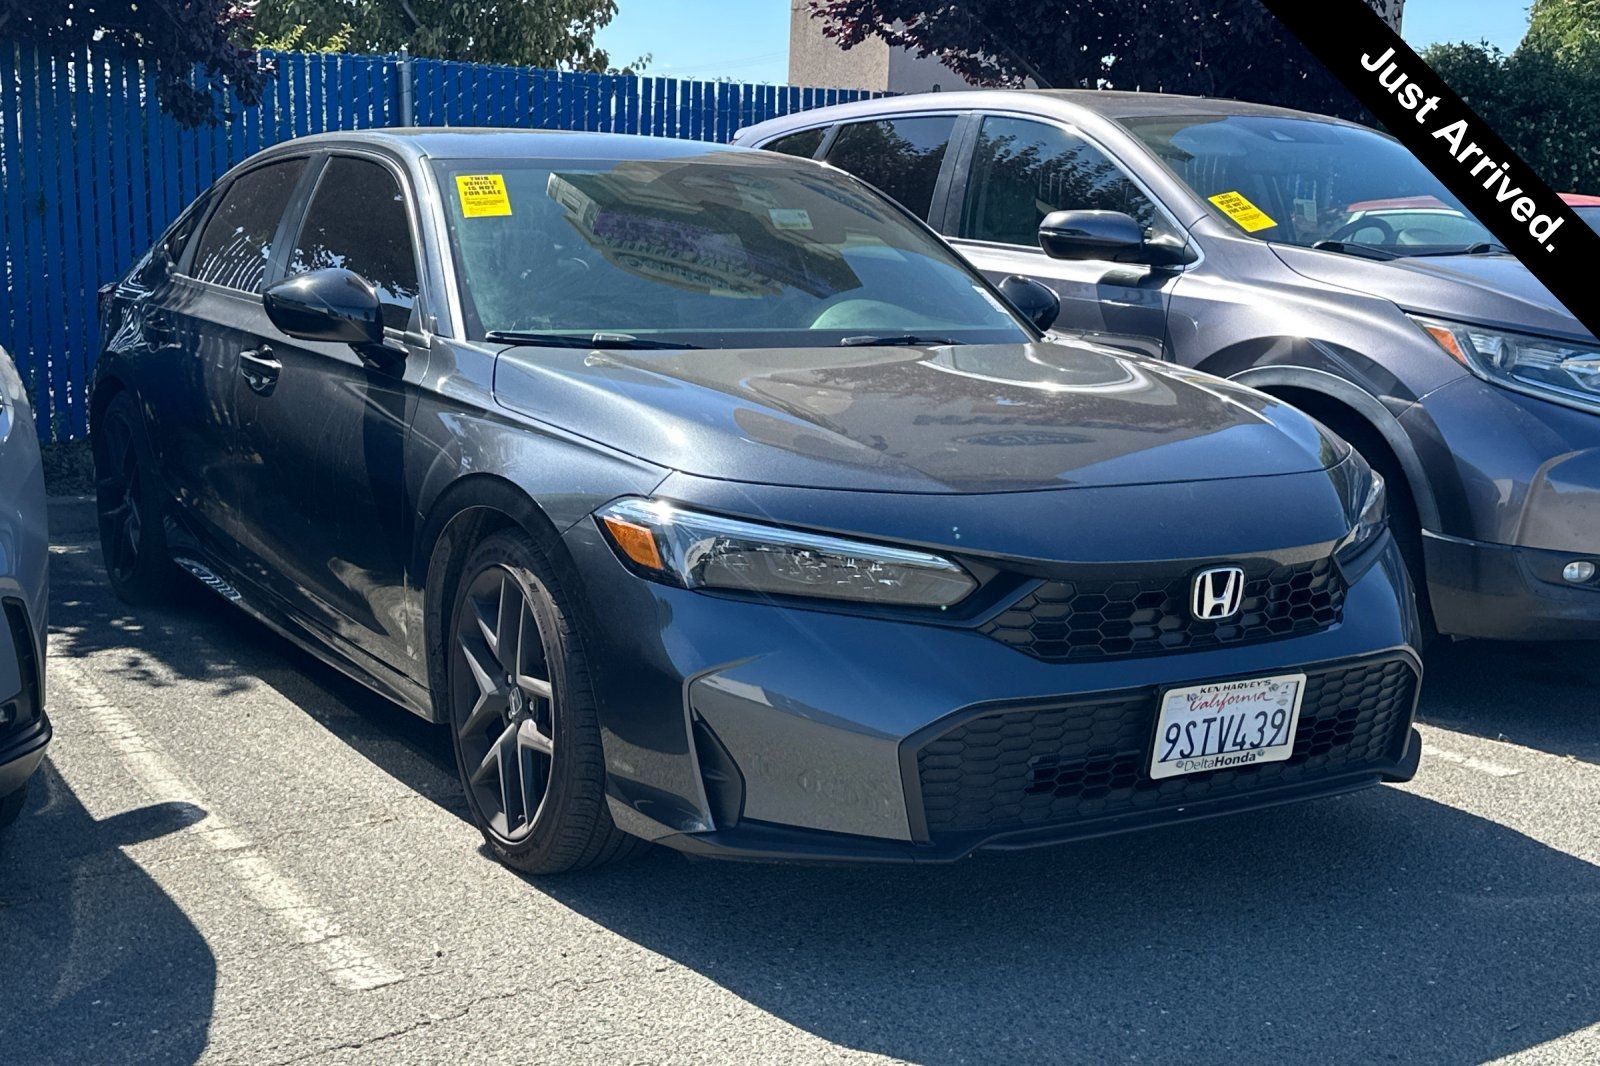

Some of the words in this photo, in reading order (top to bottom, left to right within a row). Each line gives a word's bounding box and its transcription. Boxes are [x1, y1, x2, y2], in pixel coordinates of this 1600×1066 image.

[1200, 685, 1223, 694] KEN
[1223, 679, 1272, 692] HARVEY'S
[1190, 691, 1273, 714] California
[1158, 708, 1287, 763] 9STV439
